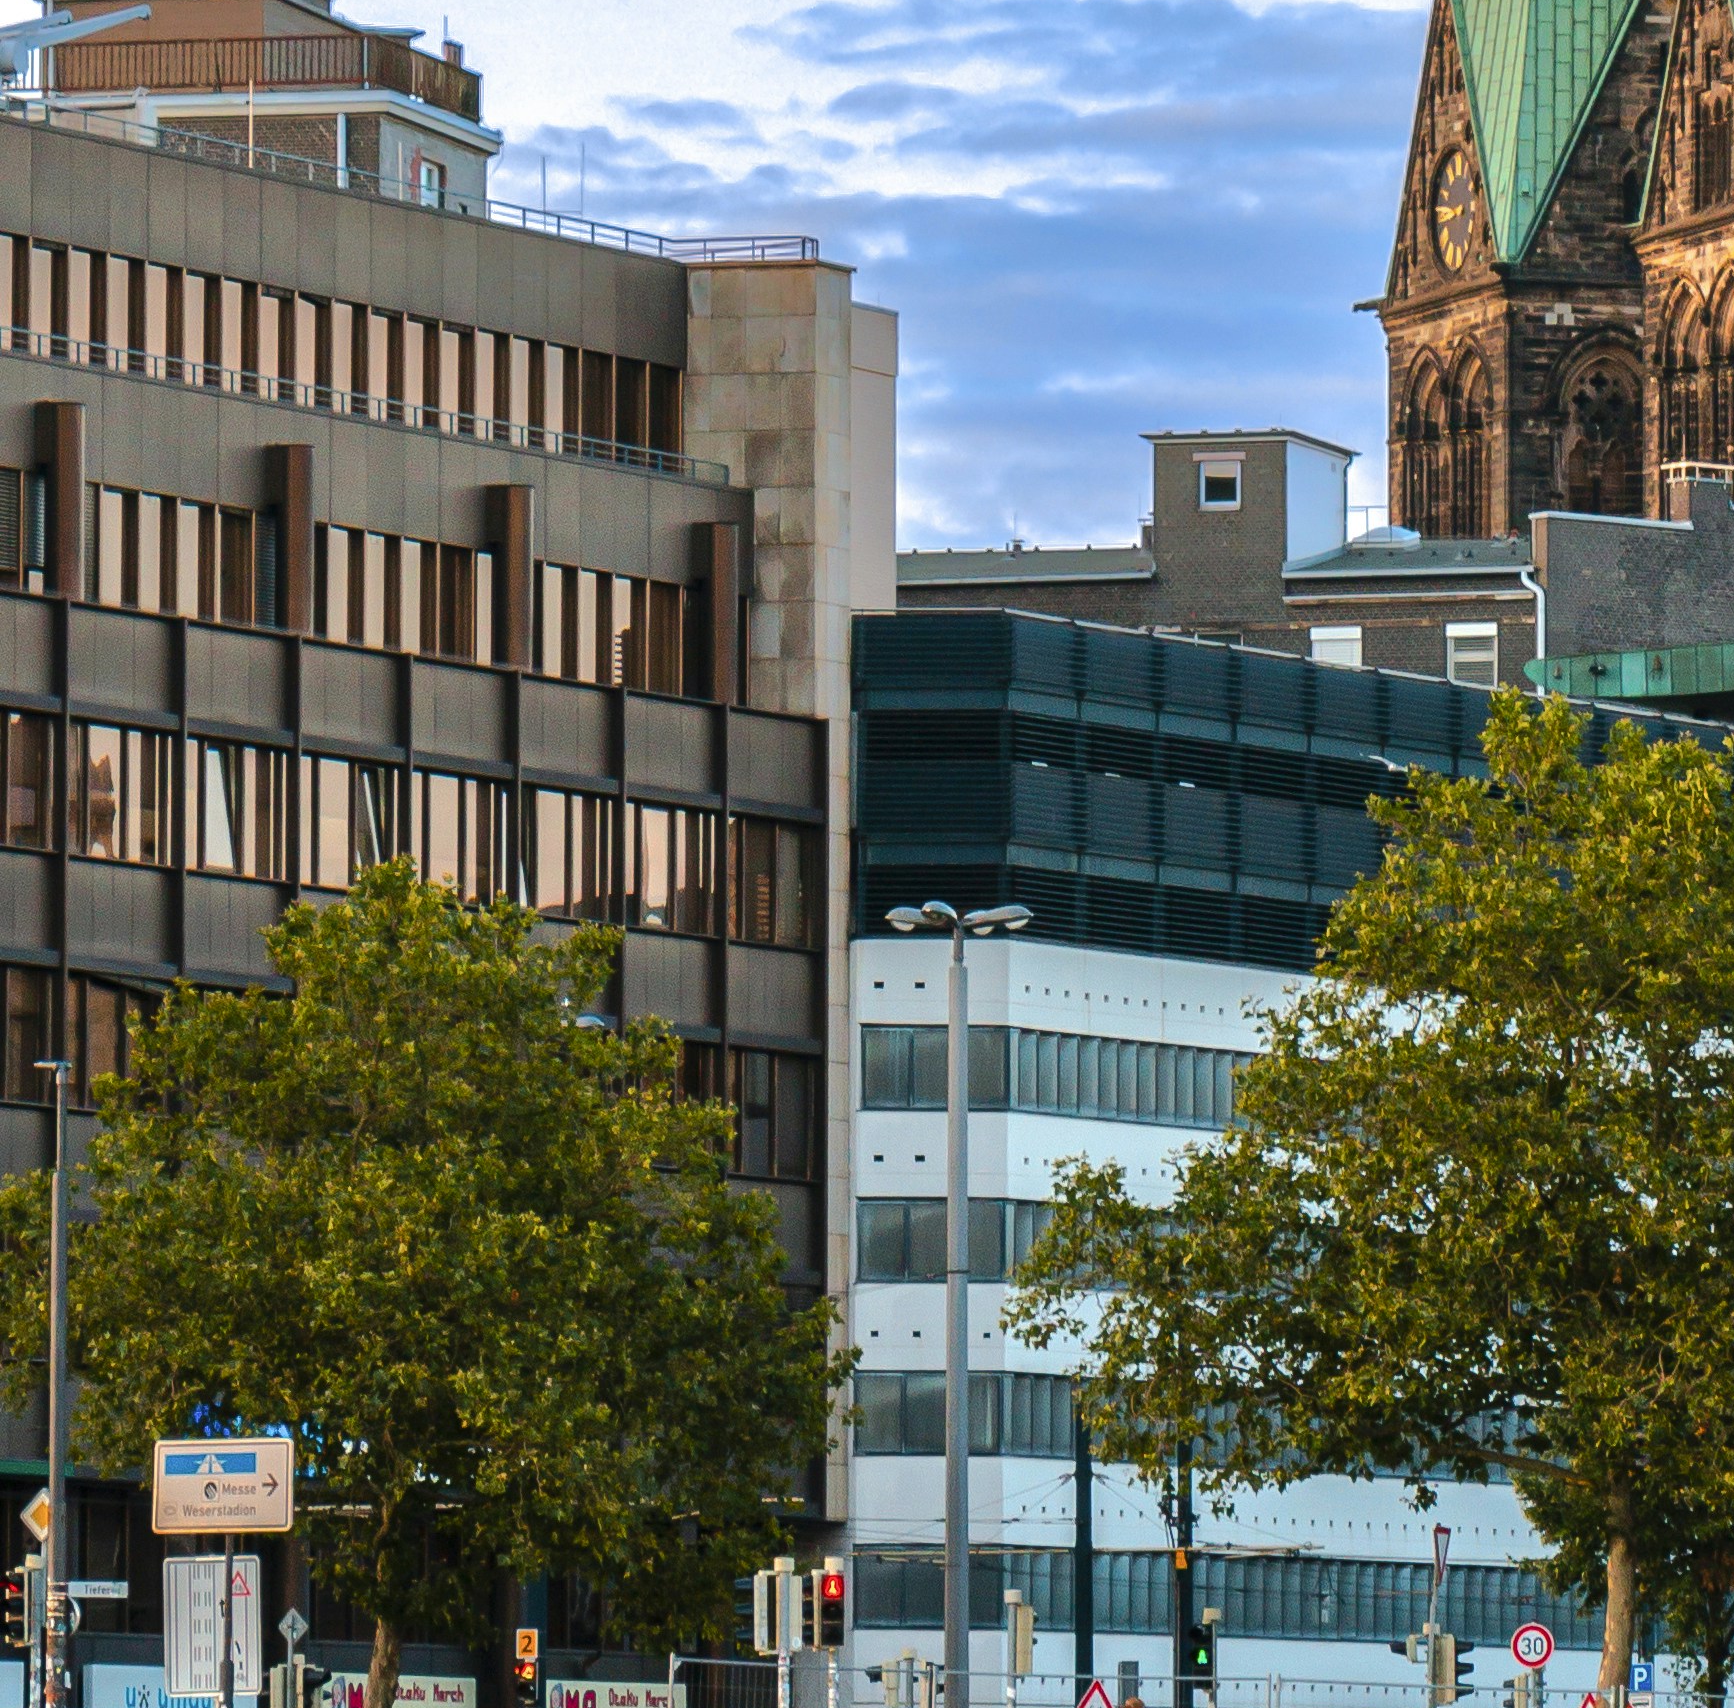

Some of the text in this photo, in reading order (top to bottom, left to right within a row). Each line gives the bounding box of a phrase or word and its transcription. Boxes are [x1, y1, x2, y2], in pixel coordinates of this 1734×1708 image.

[222, 1483, 257, 1495] Messe
[182, 1504, 257, 1517] Weserstadion
[521, 1635, 533, 1653] 2
[1521, 1637, 1544, 1656] 30
[1634, 1668, 1647, 1691] P
